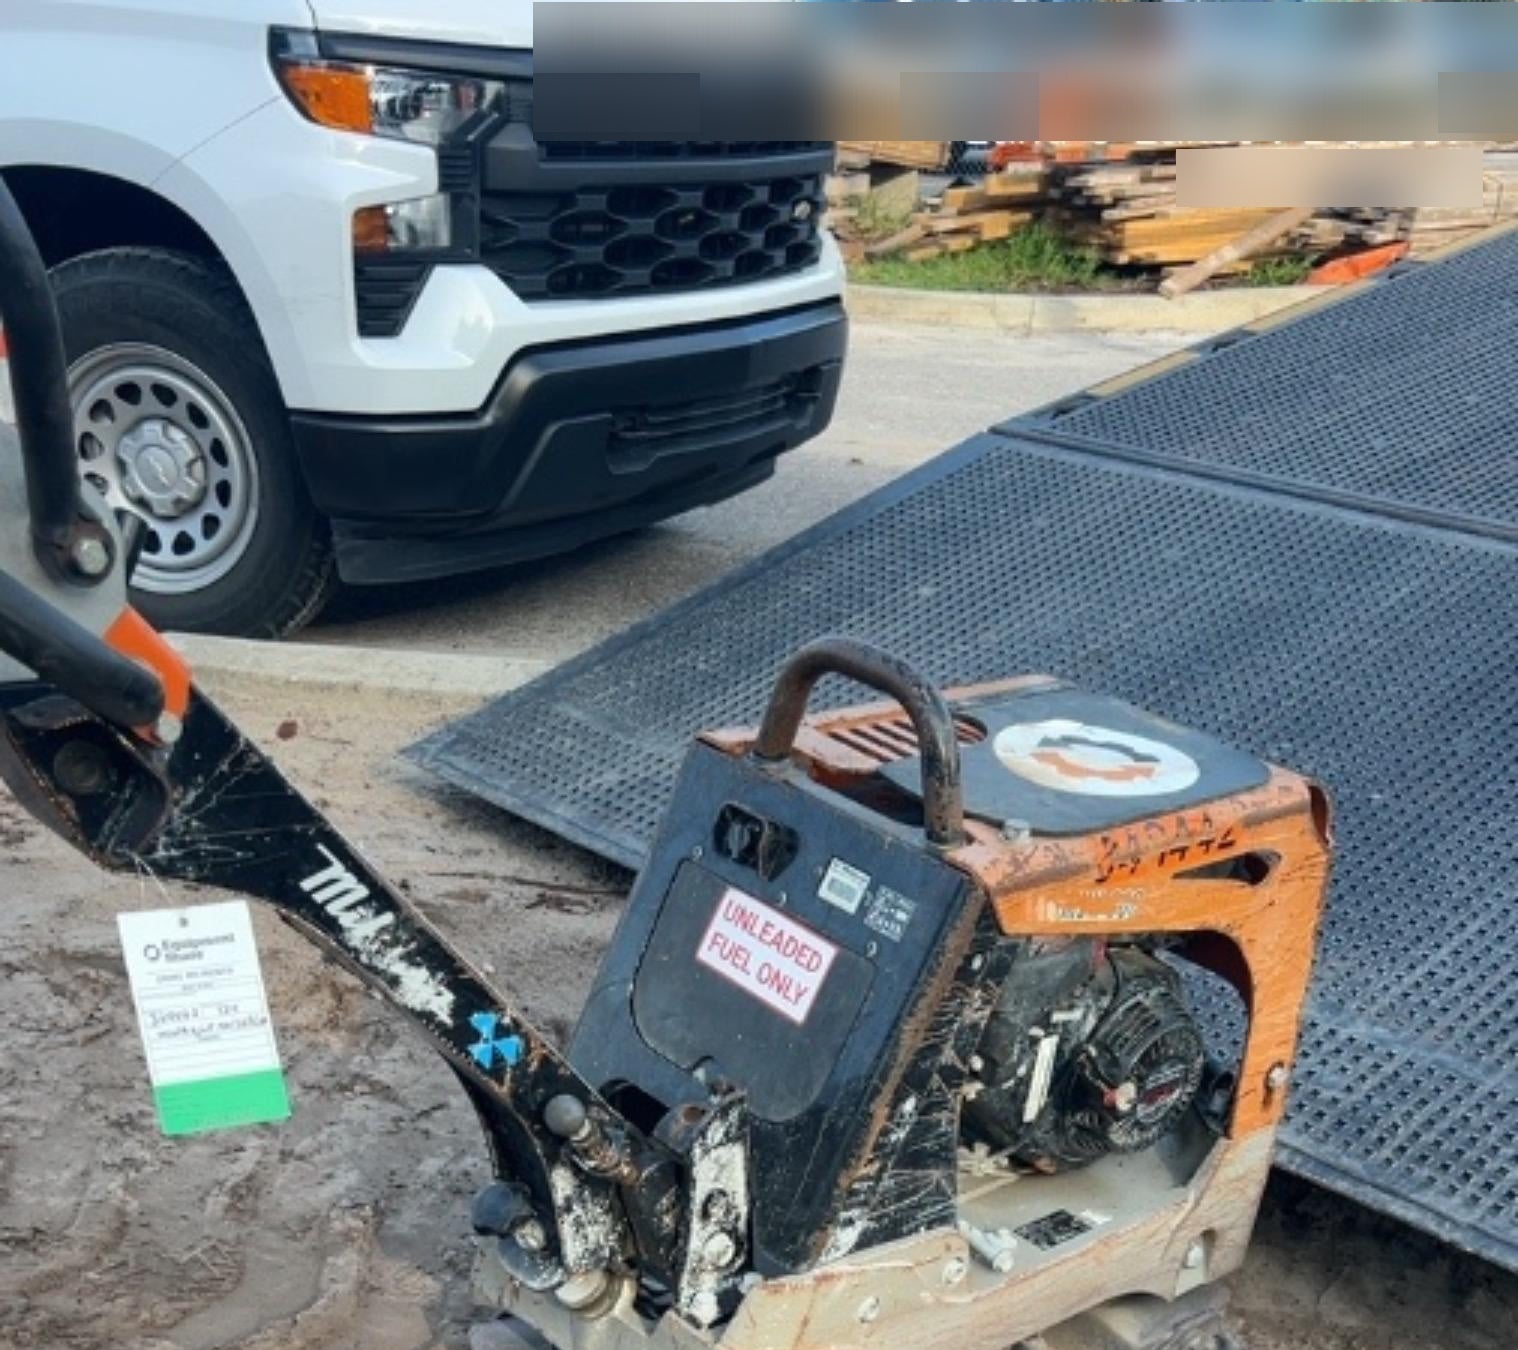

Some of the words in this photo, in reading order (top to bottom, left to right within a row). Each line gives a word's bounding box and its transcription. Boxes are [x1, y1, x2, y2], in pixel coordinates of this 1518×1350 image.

[708, 931, 751, 976] FUEL
[756, 962, 810, 1006] ONLY
[723, 899, 823, 973] UNLEADED
